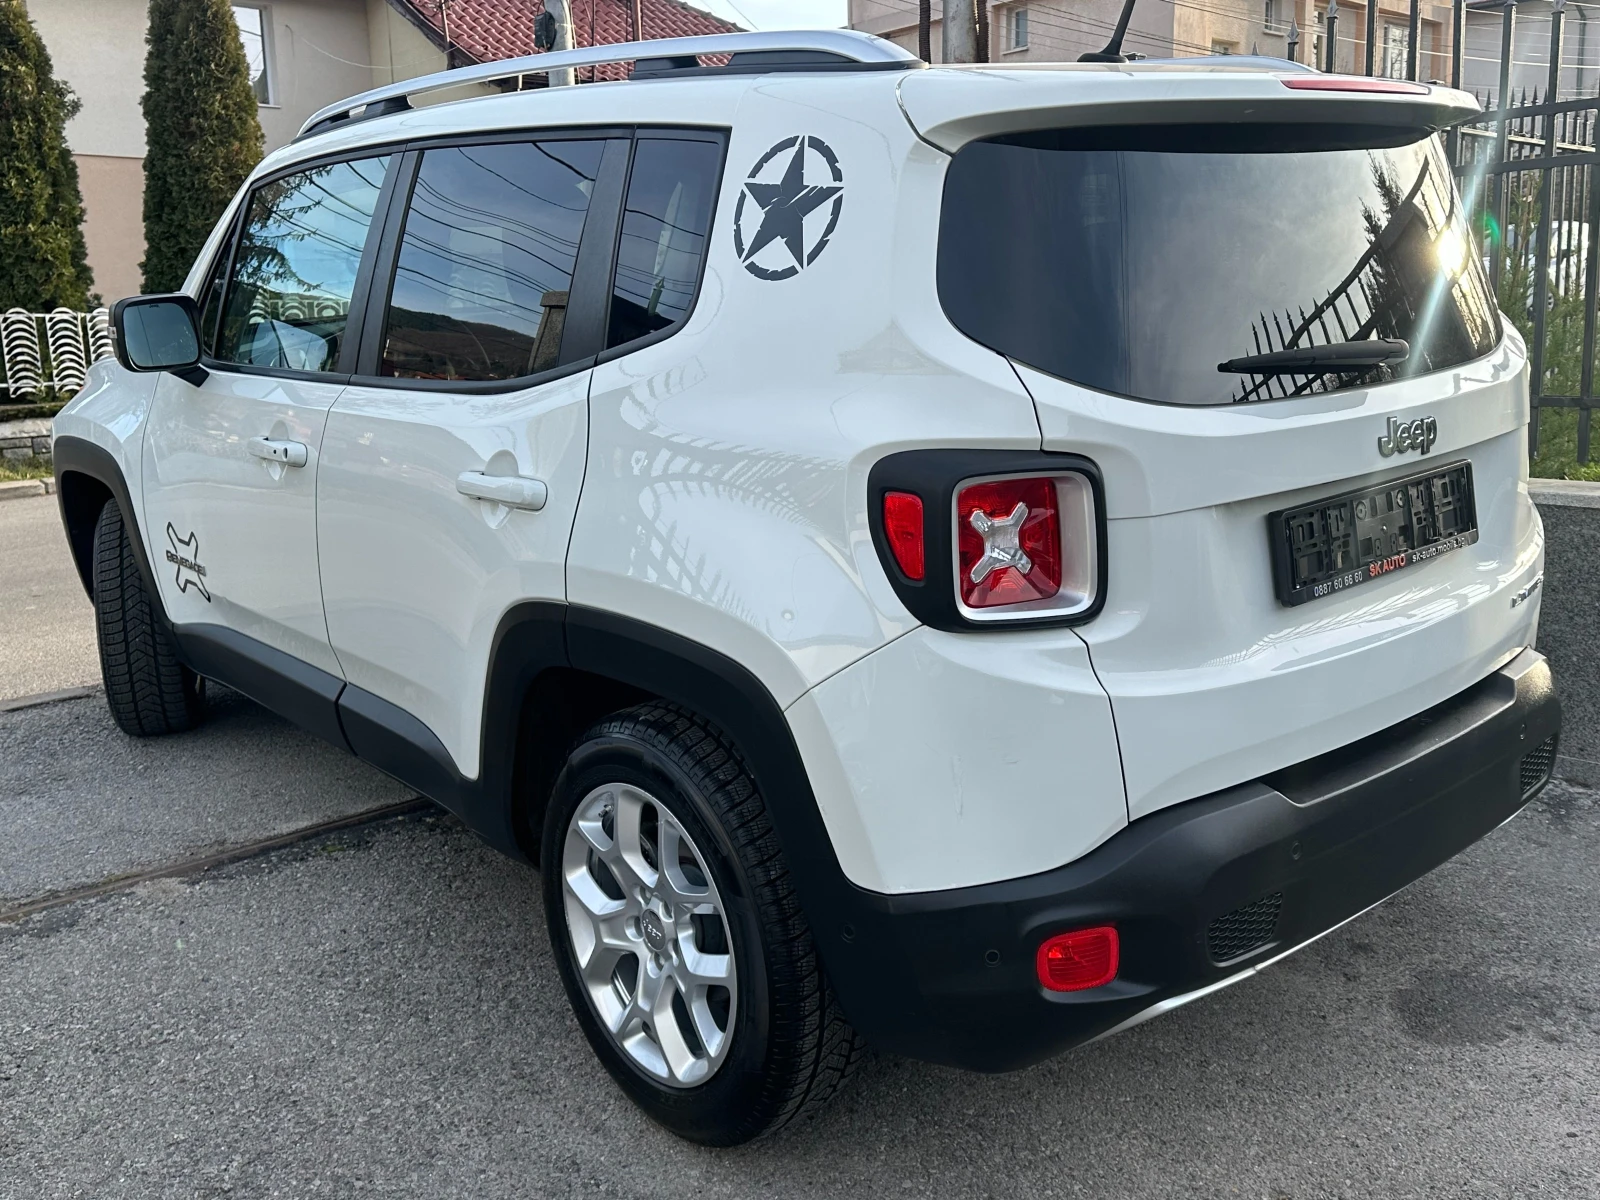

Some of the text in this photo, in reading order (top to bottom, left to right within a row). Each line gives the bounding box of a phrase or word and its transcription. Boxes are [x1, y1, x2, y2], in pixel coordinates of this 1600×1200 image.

[1378, 416, 1437, 458] Jeep
[1314, 582, 1332, 597] 0887
[1334, 578, 1343, 590] 60
[1345, 574, 1353, 586] 66
[1354, 571, 1363, 583] 60
[1369, 561, 1382, 577] SK
[1383, 554, 1406, 572] AUTO
